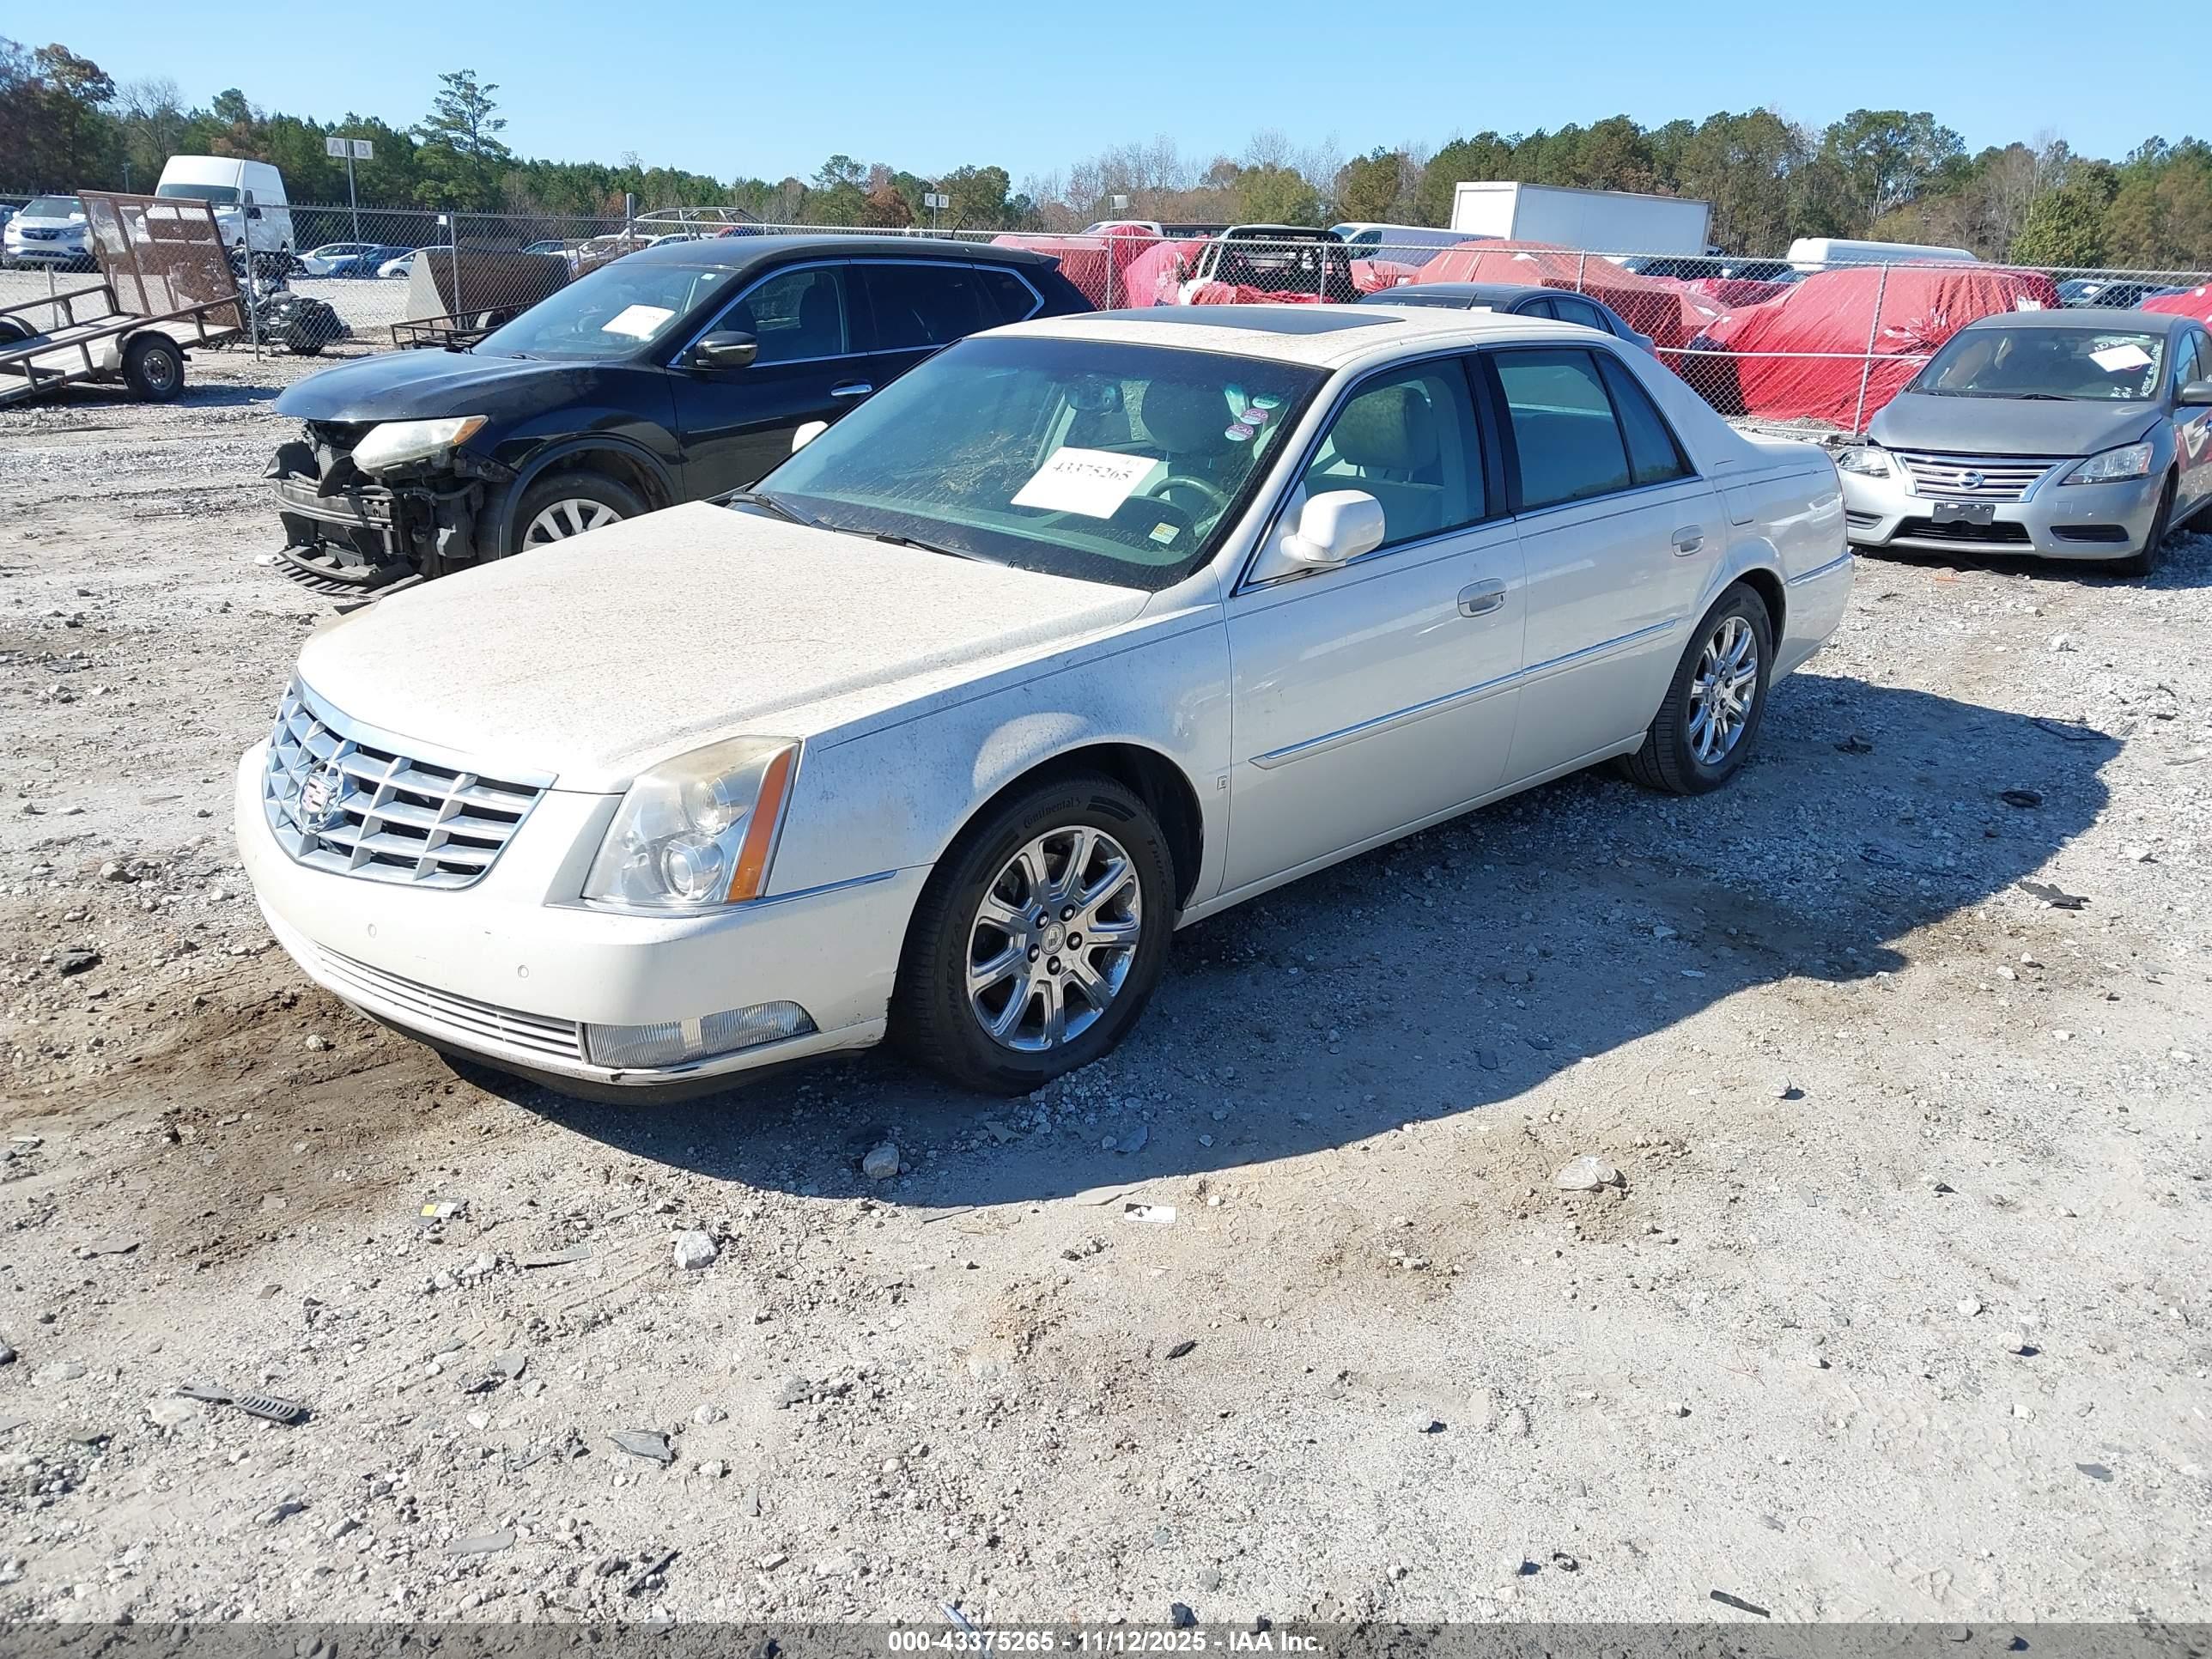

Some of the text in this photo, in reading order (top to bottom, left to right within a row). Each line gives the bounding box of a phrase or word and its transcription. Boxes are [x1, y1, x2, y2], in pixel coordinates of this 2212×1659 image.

[331, 140, 344, 155] A
[356, 142, 369, 156] B
[927, 194, 933, 205] C
[941, 196, 947, 206] D
[1244, 410, 1268, 420] SCAD
[1231, 424, 1254, 435] SCAD
[1053, 462, 1133, 481] 43375265
